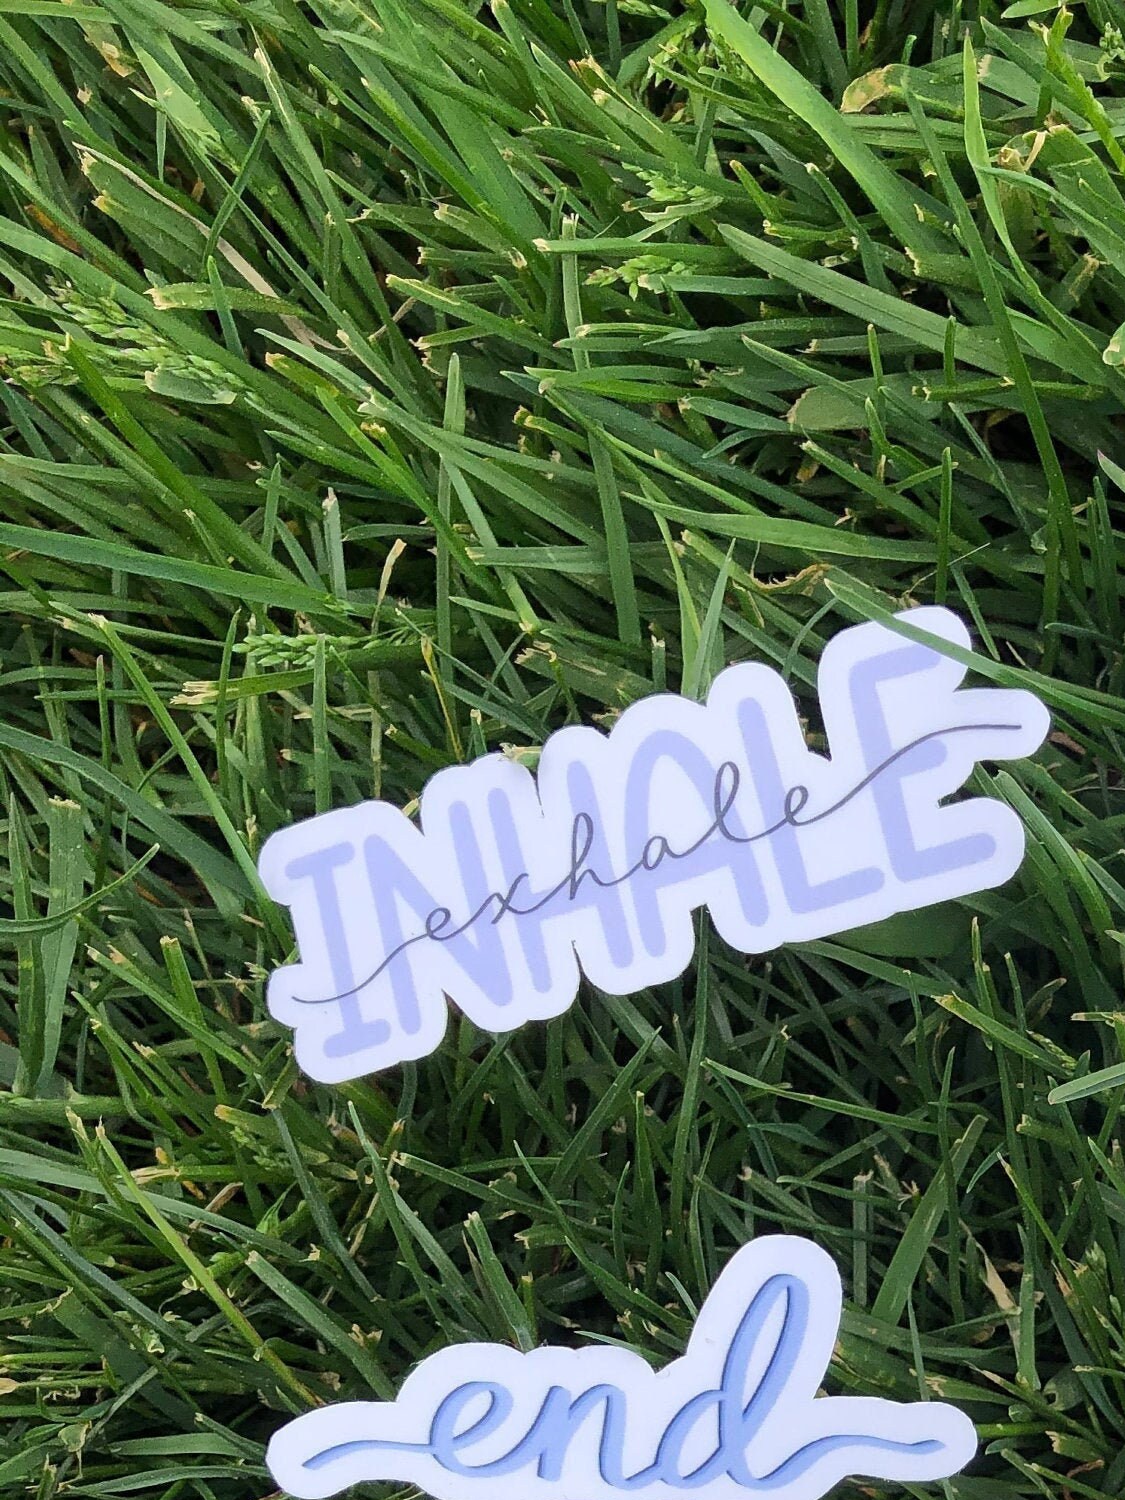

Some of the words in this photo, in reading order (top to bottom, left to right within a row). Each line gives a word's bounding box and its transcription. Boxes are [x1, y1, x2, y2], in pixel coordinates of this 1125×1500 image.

[286, 644, 996, 1058] INHALE
[292, 723, 1021, 1003] exhale
[303, 1273, 947, 1491] end
